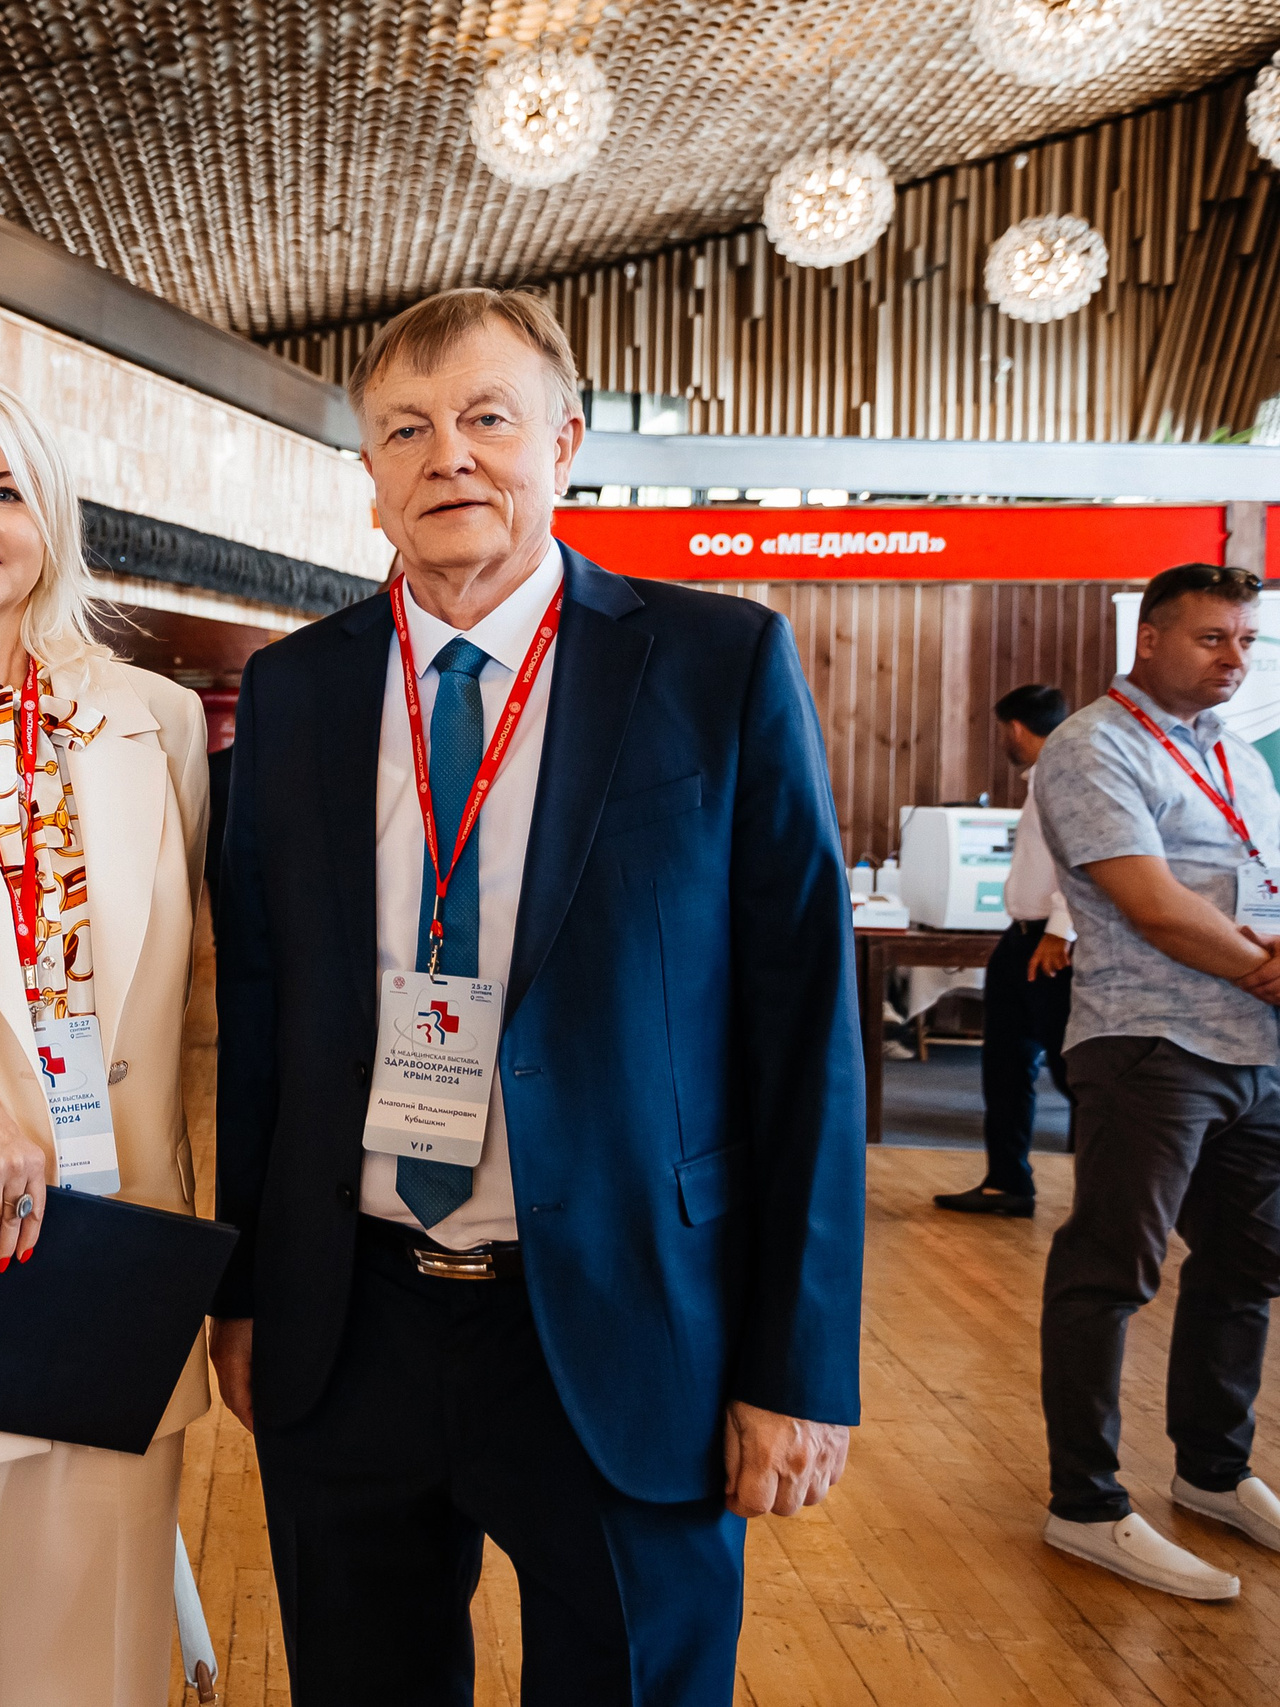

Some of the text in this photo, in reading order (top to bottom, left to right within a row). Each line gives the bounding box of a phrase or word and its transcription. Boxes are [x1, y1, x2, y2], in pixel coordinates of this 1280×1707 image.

[689, 532, 946, 558] ООО «МЕДМОЛЛ»
[522, 638, 547, 684] EXPOCRIMEA
[492, 714, 515, 762] ЭКСПОКРЫМ
[461, 791, 483, 841] EXPOCRIMEA
[472, 983, 493, 992] 25-27
[69, 1020, 90, 1029] 25-27
[398, 1050, 446, 1061] МЕДИЦИНСКАЯ
[447, 1056, 479, 1065] ВЫСТАВКА
[384, 1057, 484, 1077] ЗДРАВООХРАНЕНИЕ
[403, 1071, 460, 1085] КРЫМ 2024
[63, 1093, 95, 1102] ВЫСТАВКА
[51, 1101, 101, 1114] ХРАНЕНИЕ
[378, 1098, 477, 1118] Анатолий Владимирович
[56, 1115, 81, 1125] 2024
[405, 1115, 446, 1127] Кубышкин
[411, 1142, 433, 1152] VIP
